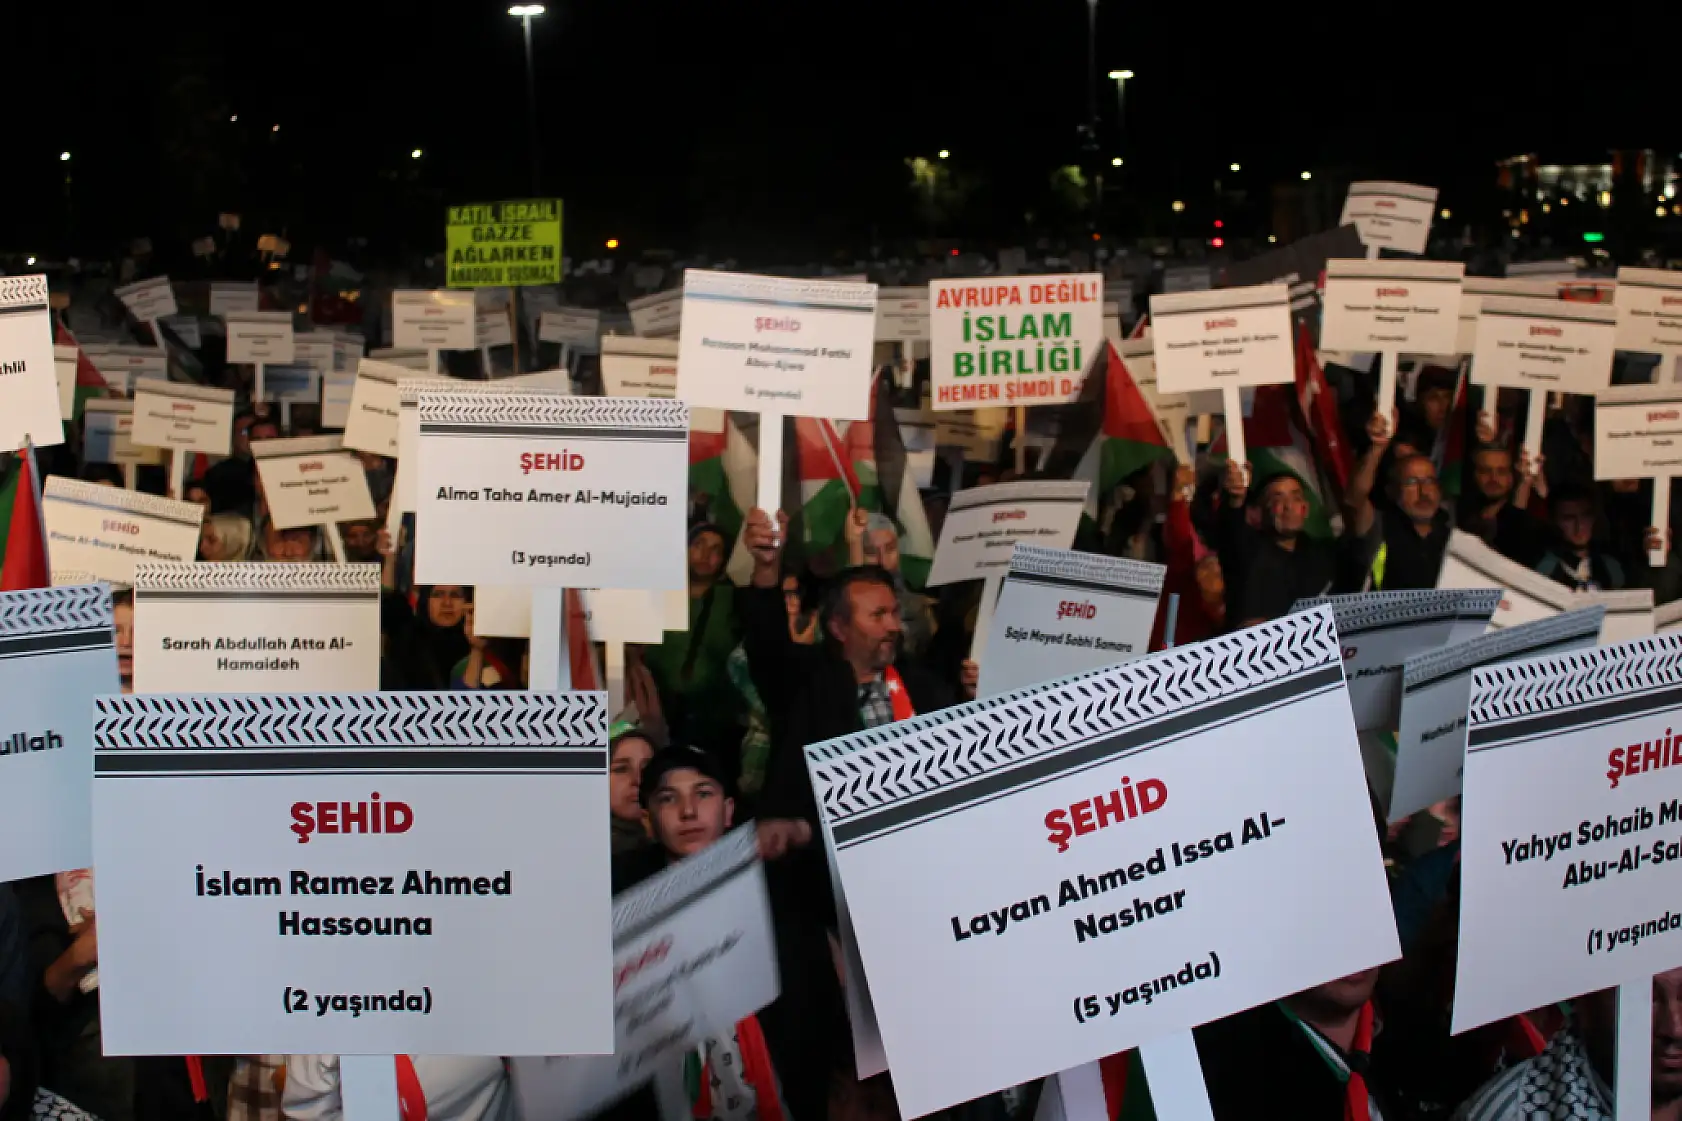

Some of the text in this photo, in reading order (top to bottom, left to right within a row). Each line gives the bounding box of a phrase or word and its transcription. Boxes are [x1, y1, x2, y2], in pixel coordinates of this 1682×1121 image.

[453, 245, 554, 264] AĞLARKEN
[937, 279, 1098, 310] AVRUPA DEĞİL!
[755, 316, 801, 332] ŞEHİD
[963, 312, 1072, 343] İSLAM
[953, 341, 1082, 378] BİRLİĞİ
[938, 384, 1000, 403] HEMEN
[1007, 376, 1056, 402] ŞİMDİ
[519, 449, 586, 475] ŞEHİD
[436, 486, 668, 508] Alma Taha Amer Al-Mujaida
[512, 551, 591, 567] (3 yaşında)
[1056, 600, 1097, 621] ŞEHİD
[162, 637, 353, 651] Sarah Abdullah Atta Al-
[217, 658, 300, 672] Hamaideh
[290, 791, 414, 844] ŞEHİD
[1044, 776, 1169, 854] ŞEHİD
[1502, 798, 1682, 866] Yahya Sohaib M
[950, 811, 1286, 942] Layan Ahmed Issa Al-
[1562, 835, 1682, 890] Abu-Al-Sa
[195, 864, 512, 896] İslam Ramez Ahmed
[278, 911, 432, 936] Hassouna
[1073, 889, 1186, 943] Nashar
[1587, 928, 1602, 956] (1
[283, 986, 432, 1018] (2 yaşında)
[1073, 951, 1222, 1024] (5 yaşında)
